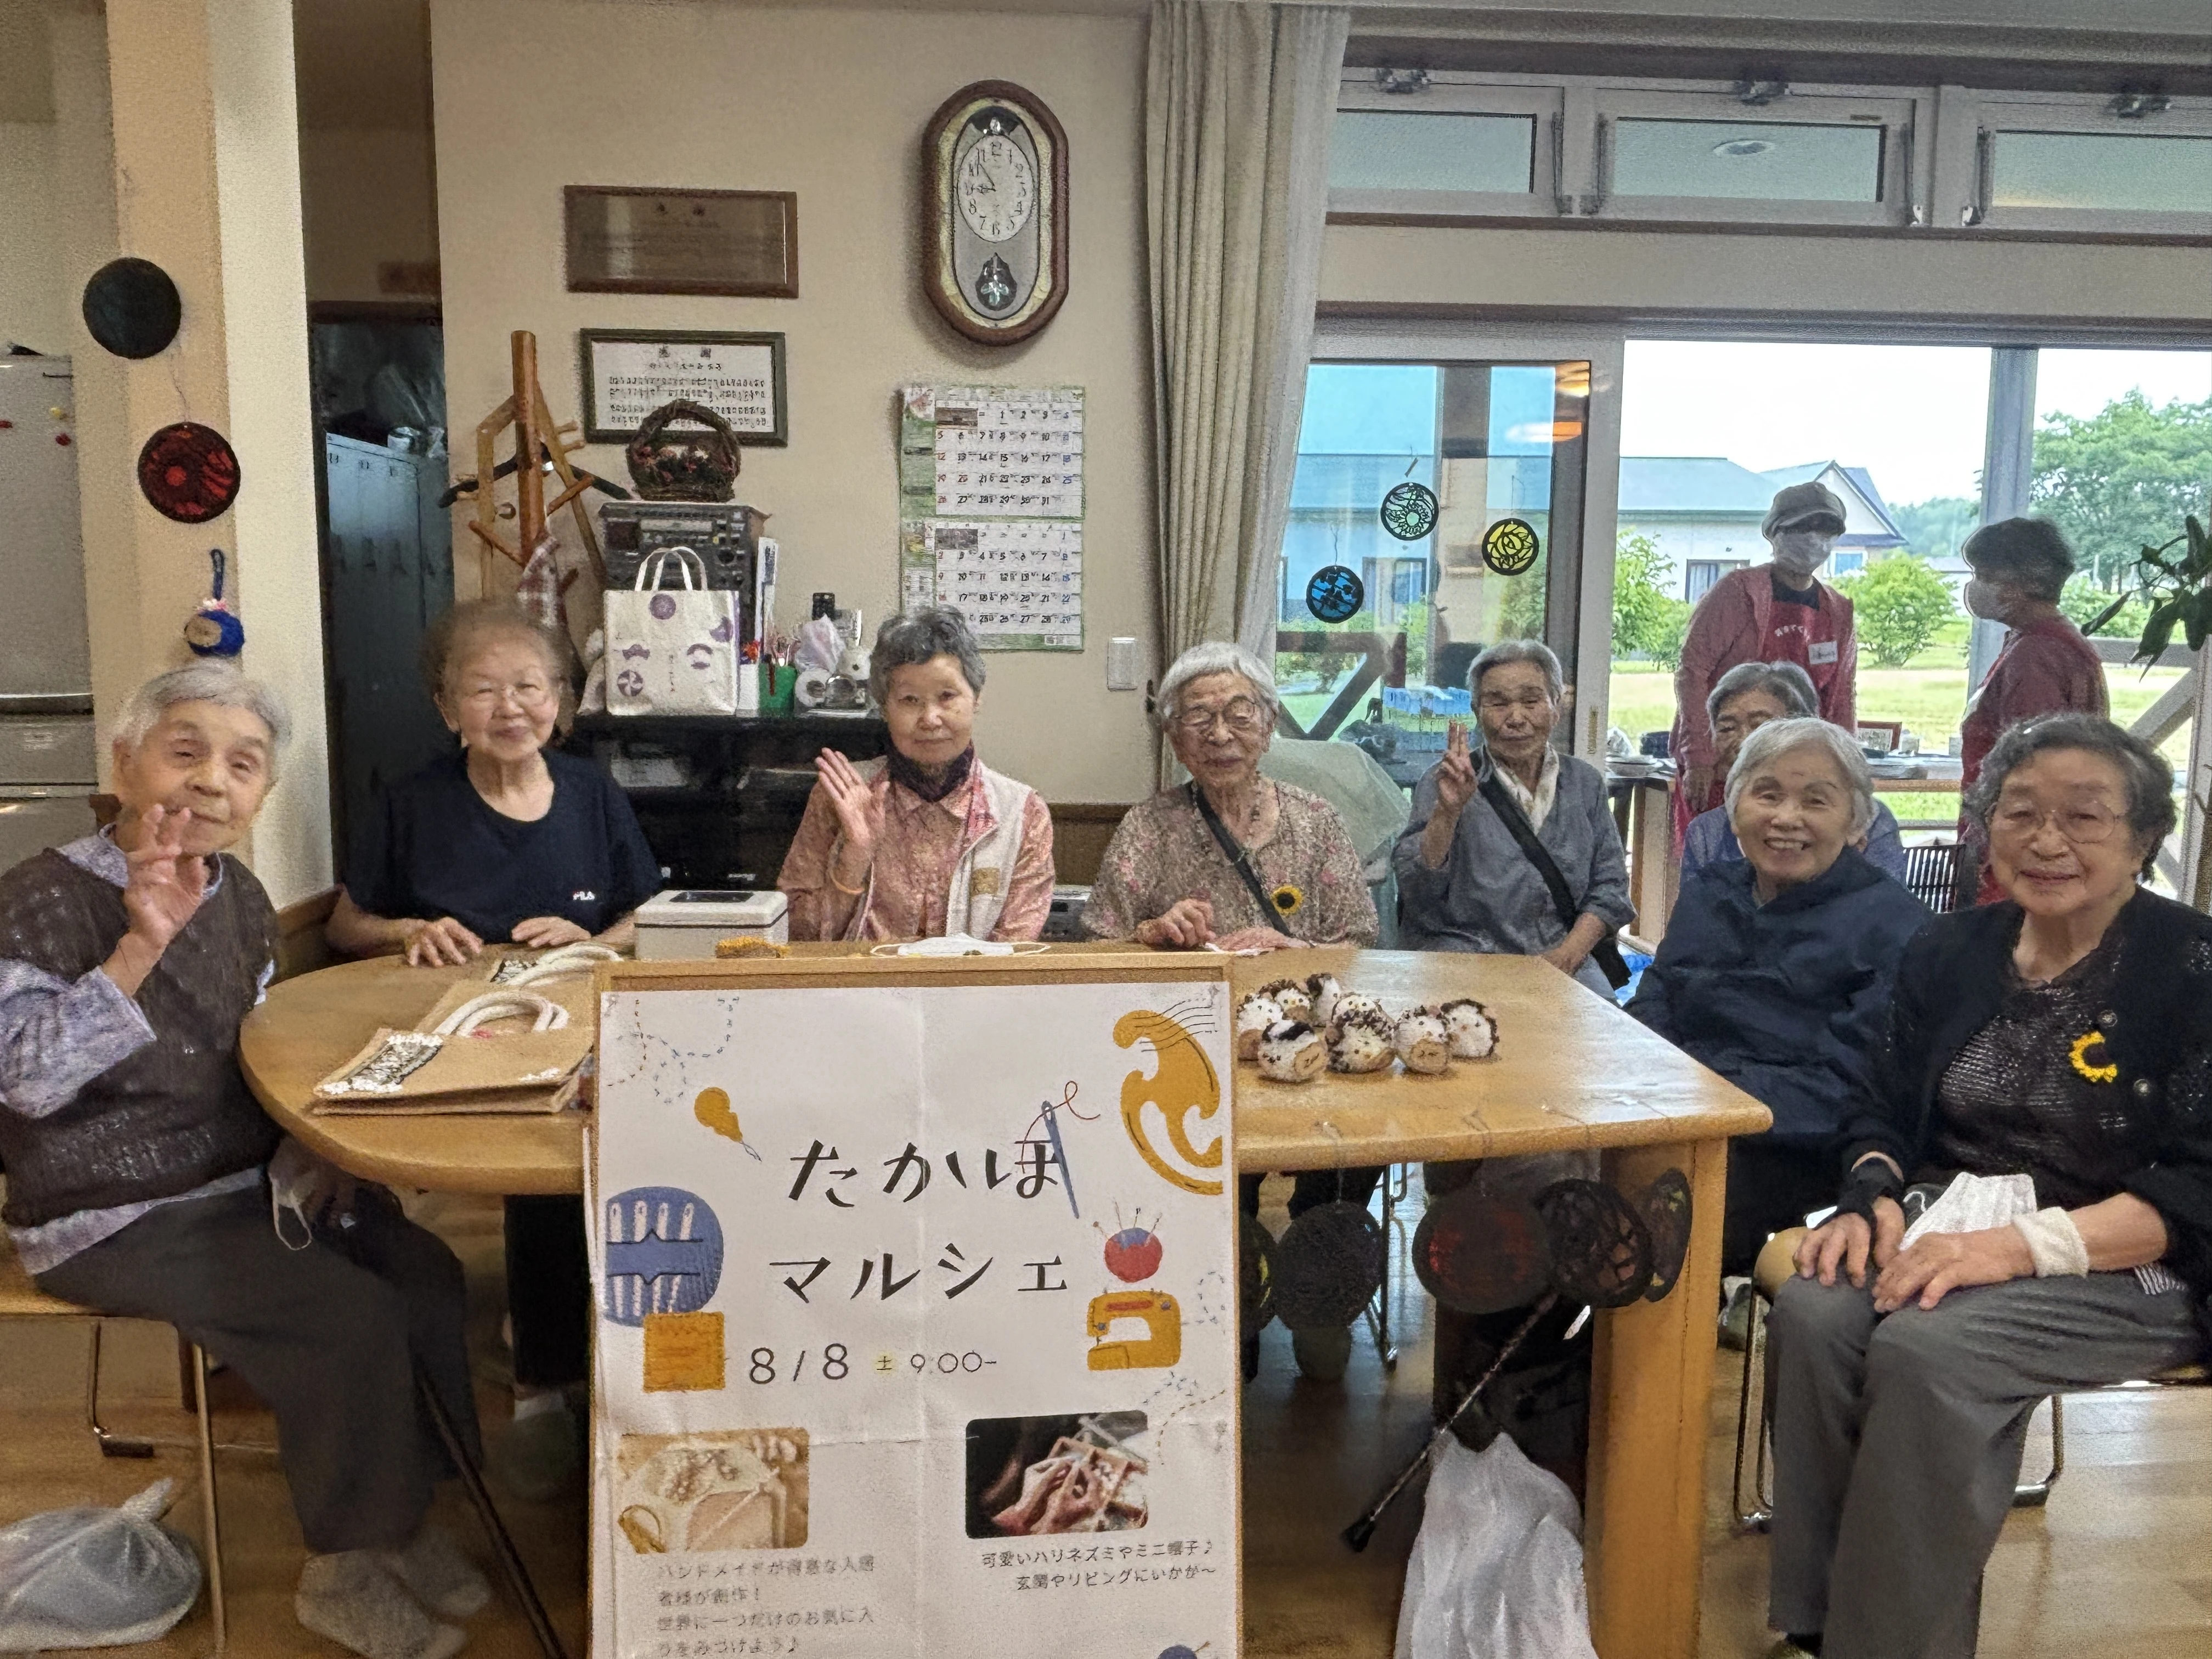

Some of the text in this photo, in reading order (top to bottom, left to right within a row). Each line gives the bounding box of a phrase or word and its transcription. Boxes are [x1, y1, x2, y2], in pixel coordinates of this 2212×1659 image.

[769, 1243, 1067, 1304] マルシェ
[877, 1356, 893, 1370] 土
